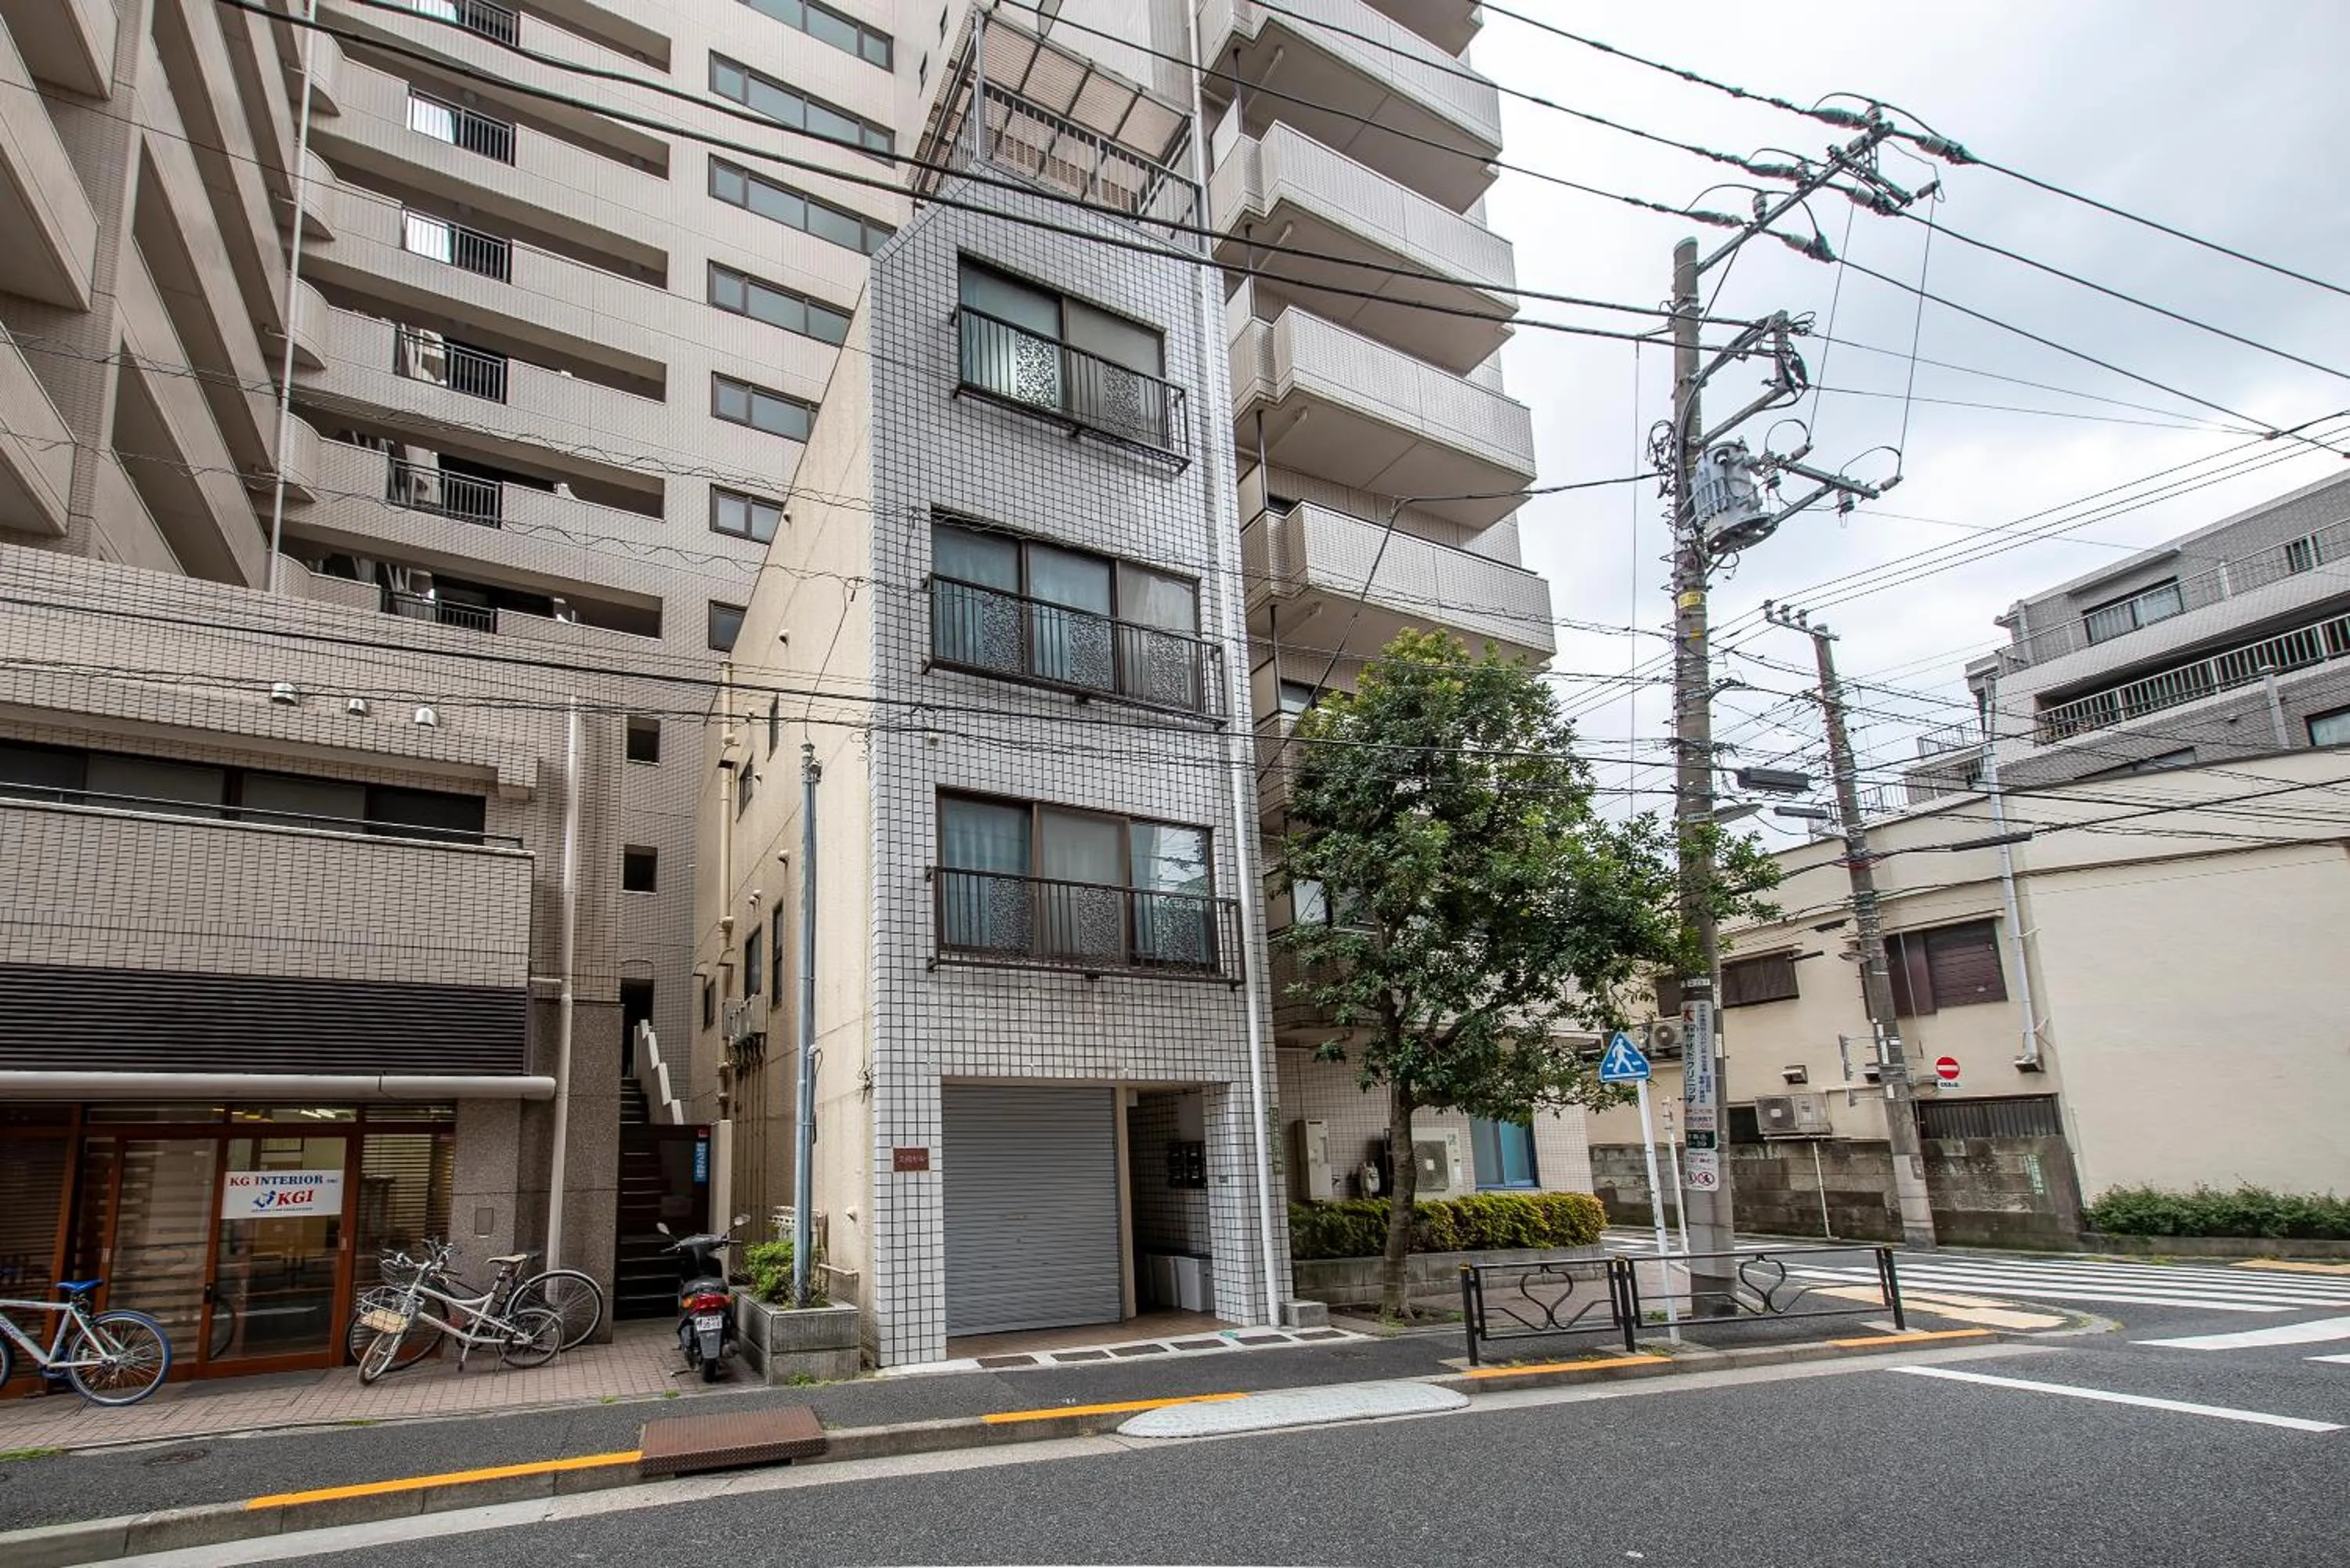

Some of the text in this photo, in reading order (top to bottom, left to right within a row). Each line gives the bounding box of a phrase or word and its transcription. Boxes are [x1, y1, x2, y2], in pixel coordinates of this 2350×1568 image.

[230, 1176, 251, 1187] KG
[255, 1175, 324, 1186] INTERIOR
[277, 1189, 315, 1206] KGI
